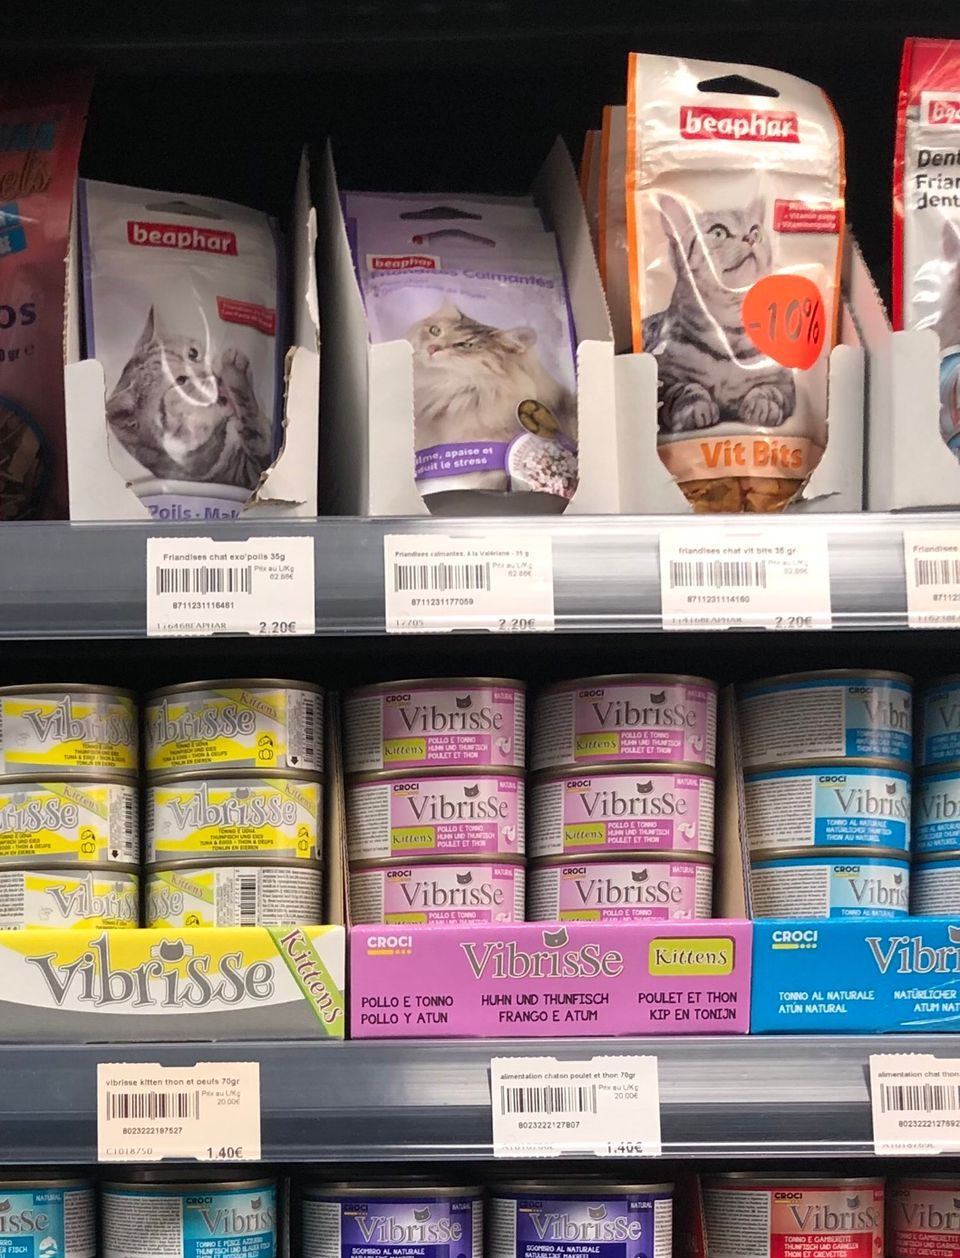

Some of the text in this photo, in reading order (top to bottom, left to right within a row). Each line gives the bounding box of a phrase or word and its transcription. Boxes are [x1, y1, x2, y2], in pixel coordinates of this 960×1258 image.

[685, 113, 793, 139] beaphar
[132, 226, 231, 254] beaphar
[373, 257, 433, 270] beaphar
[750, 299, 819, 346] -10%
[702, 442, 803, 468] Vit Bits
[451, 457, 487, 469] stress
[259, 622, 296, 633] 2.20€
[499, 618, 536, 630] 2.20€
[776, 616, 812, 628] 2.20€
[367, 936, 412, 948] CROCI
[655, 948, 727, 965] Kittens
[280, 928, 343, 1024] Kittens
[361, 996, 454, 1008] POLLO E TONNO
[639, 992, 737, 1004] POULET ET THON
[650, 1008, 736, 1021] KIP EN TONIJN
[208, 1147, 243, 1158] 1.40€
